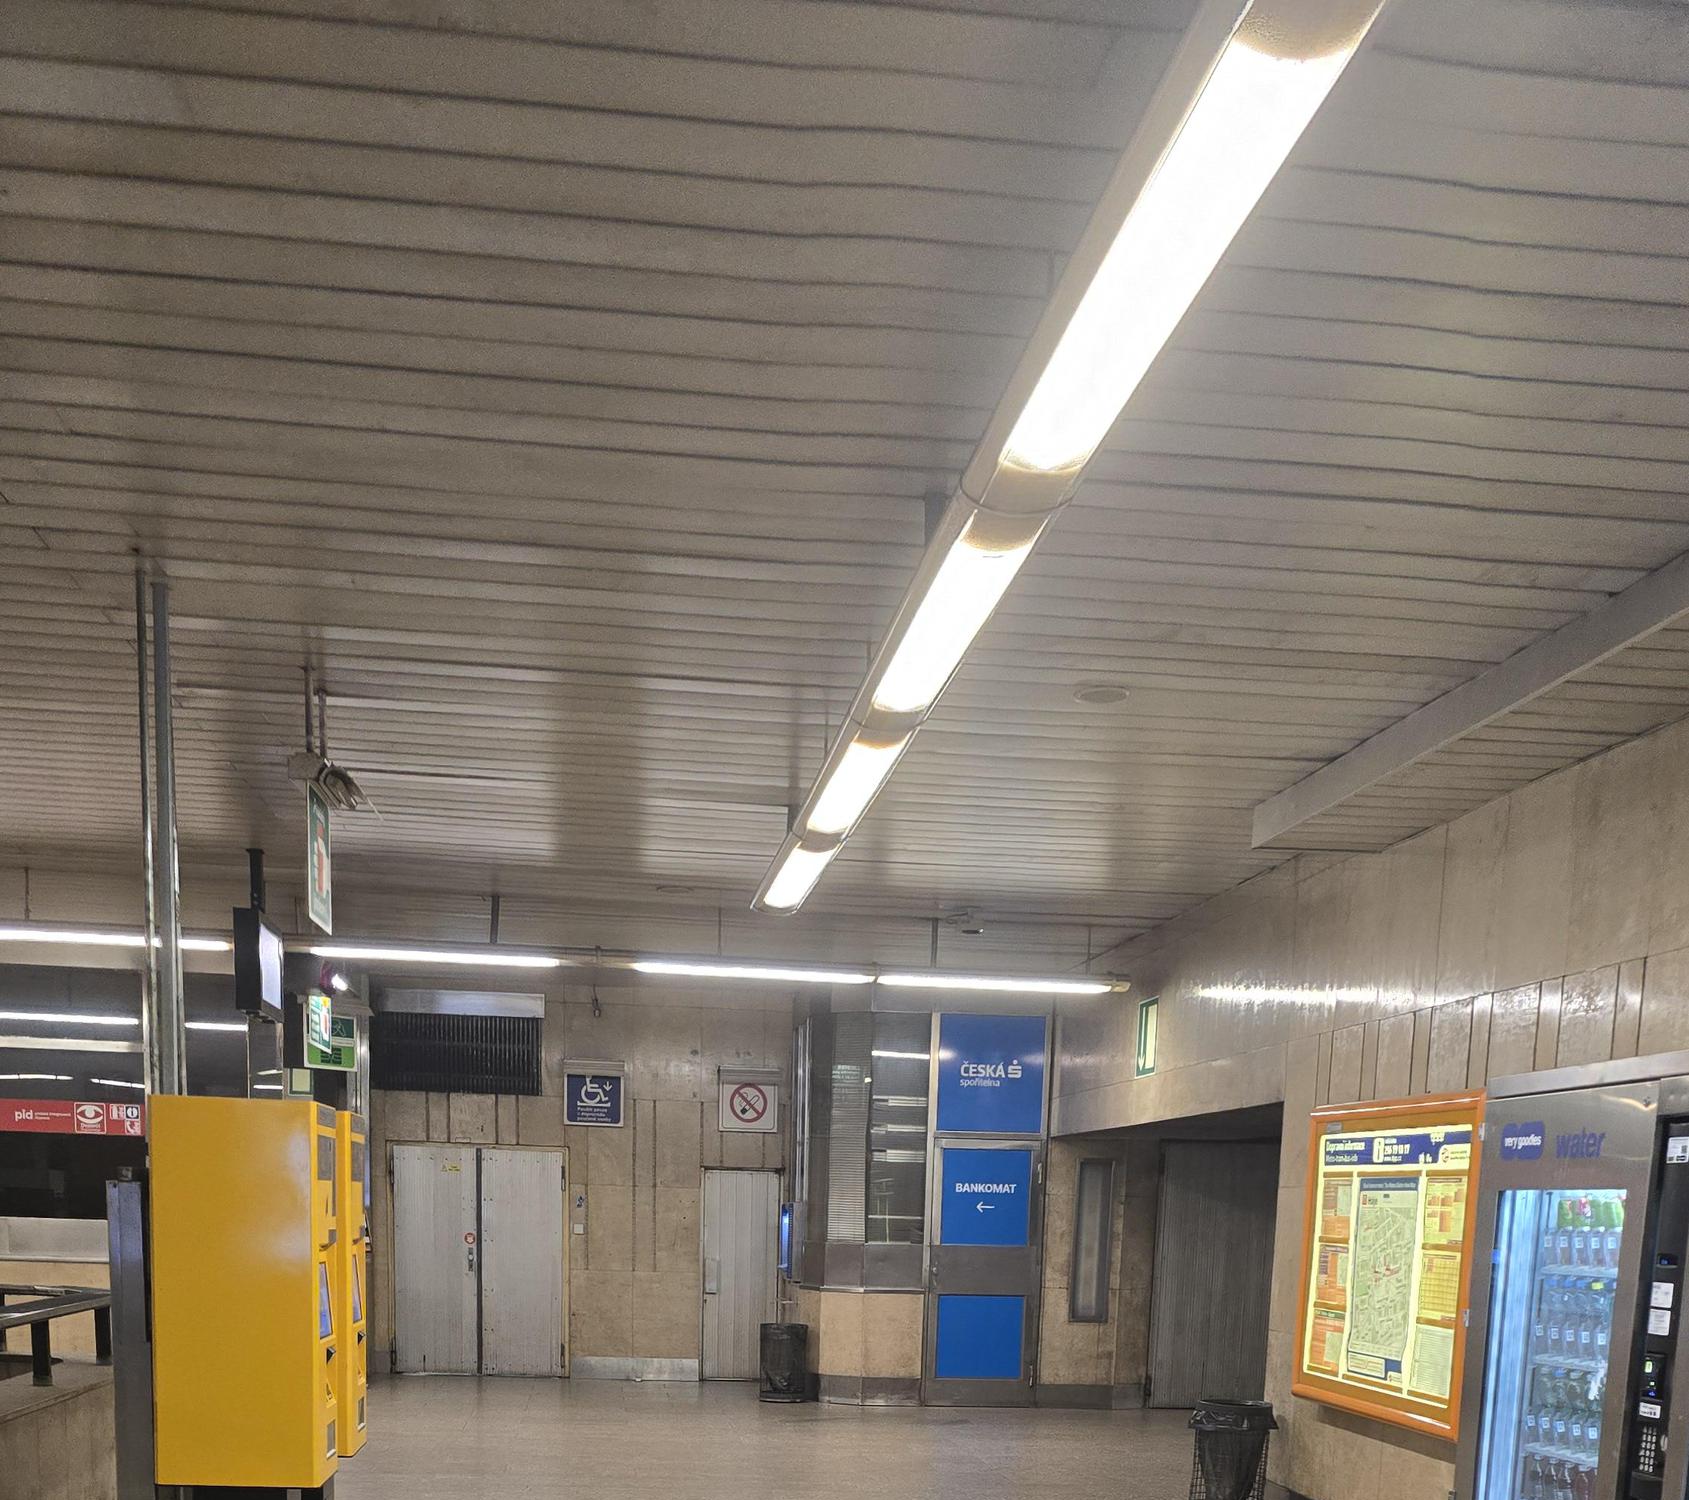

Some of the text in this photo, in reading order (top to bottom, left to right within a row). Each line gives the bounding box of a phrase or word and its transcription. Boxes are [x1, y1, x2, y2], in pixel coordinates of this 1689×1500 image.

[960, 1061, 1005, 1078] ČESKÁ
[960, 1078, 1000, 1087] spořitelna
[1505, 1134, 1541, 1149] very goodies
[1556, 1127, 1605, 1158] water
[955, 1183, 1017, 1193] BANKOMAT
